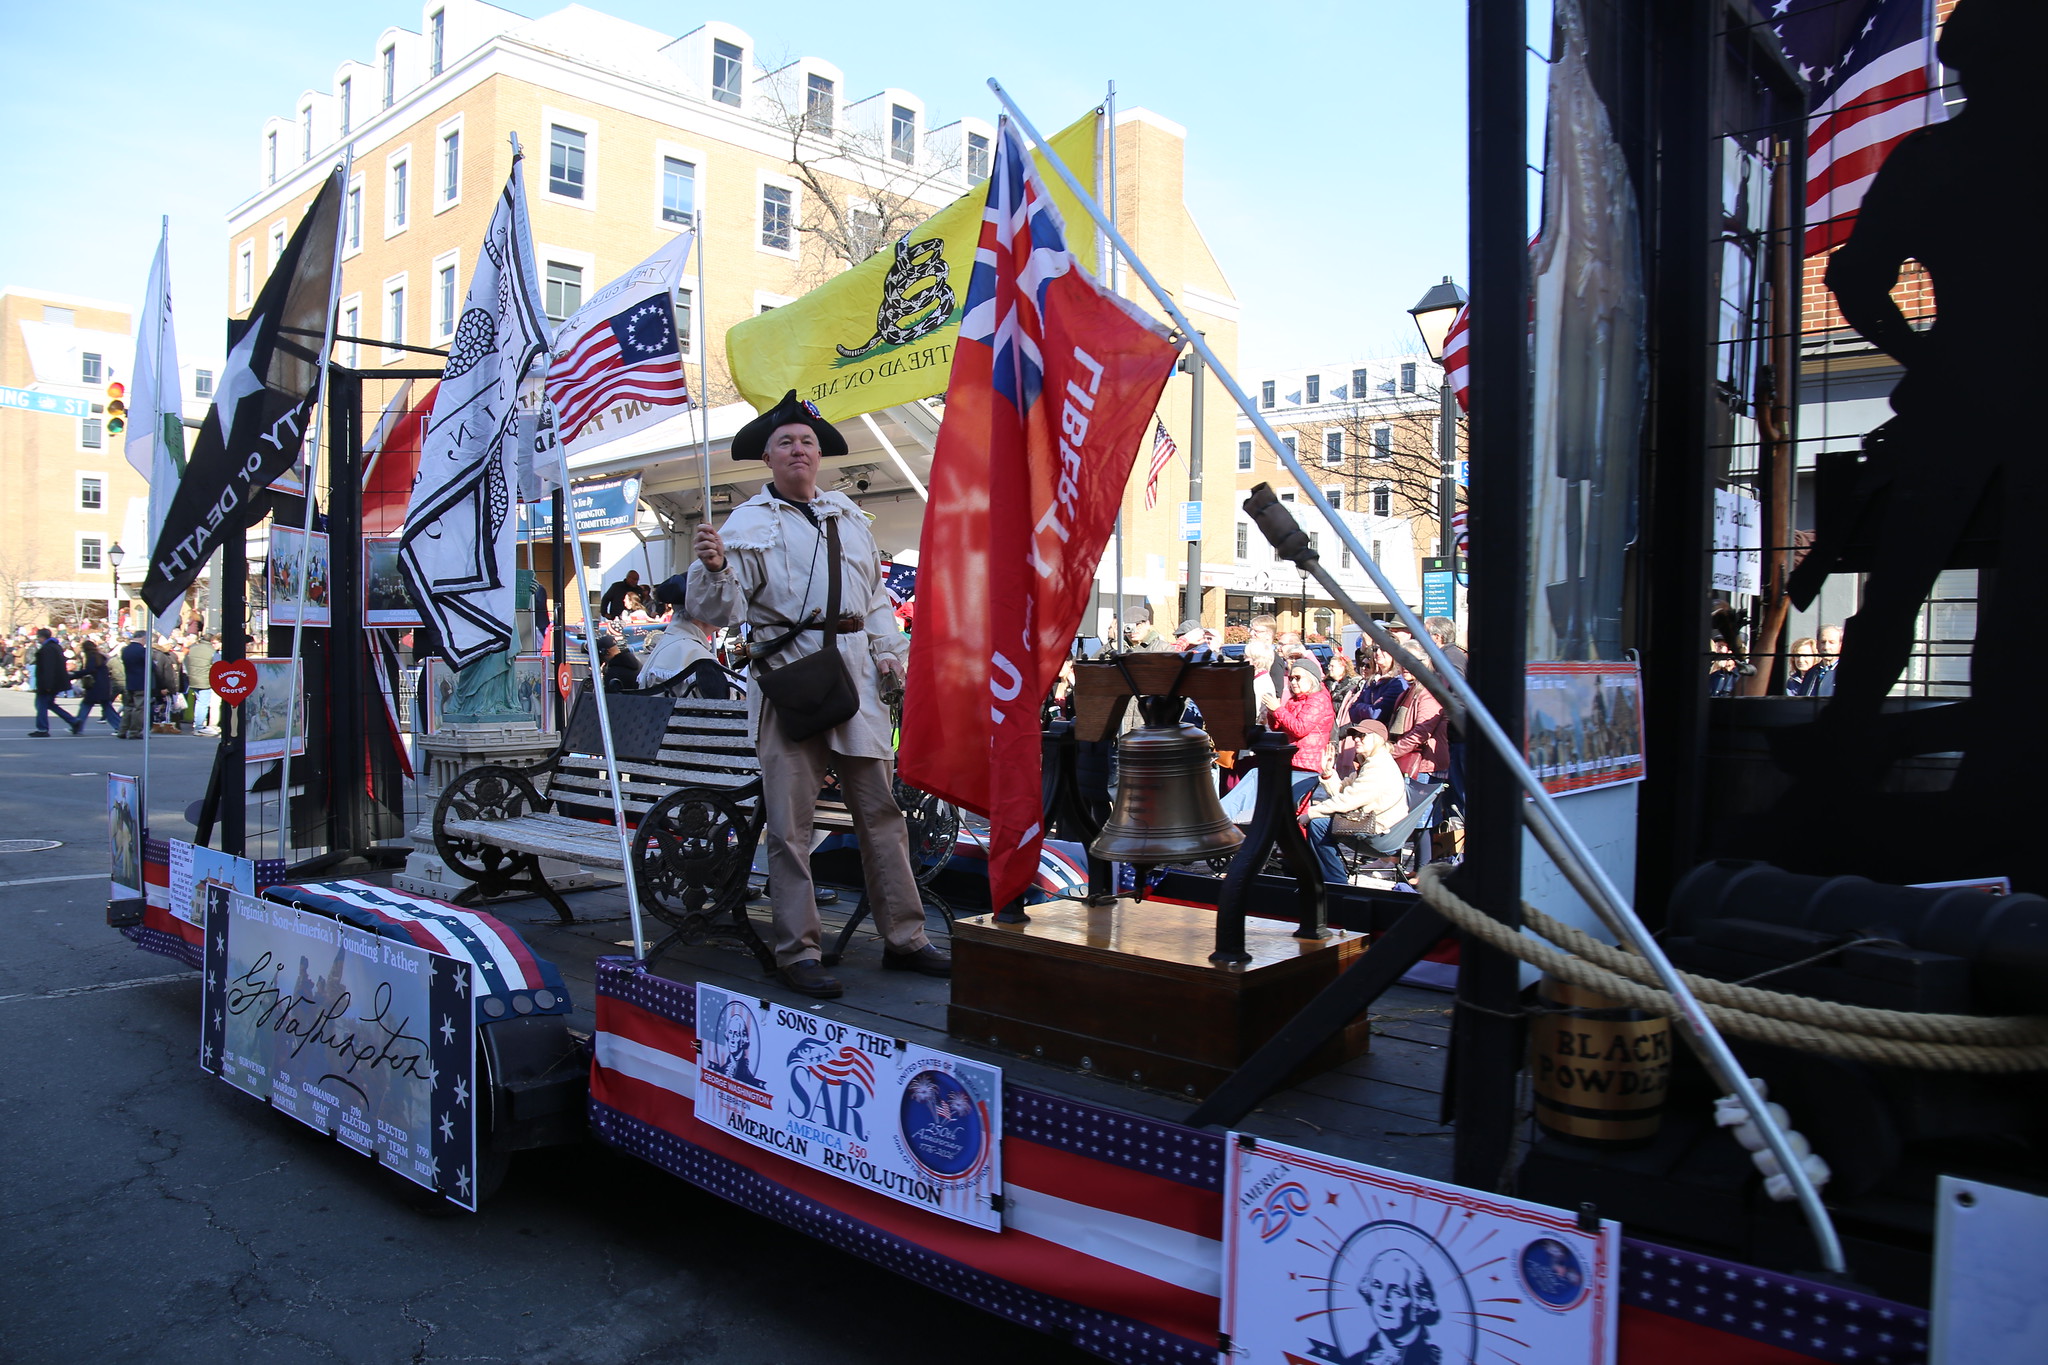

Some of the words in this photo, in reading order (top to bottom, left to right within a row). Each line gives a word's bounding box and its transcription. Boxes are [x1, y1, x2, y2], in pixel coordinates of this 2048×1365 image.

[64, 399, 85, 415] ST
[218, 670, 247, 680] Alexandria
[220, 686, 248, 694] George
[235, 898, 269, 924] Virginia's
[272, 910, 334, 944] Son-America's
[336, 929, 379, 963] Founding
[382, 945, 419, 974] Father
[777, 1009, 818, 1036] SONS
[825, 1023, 848, 1044] OF
[856, 1032, 894, 1059] THE
[1556, 1030, 1668, 1063] BLACK
[238, 1055, 266, 1076] SURVEYOR
[897, 1062, 918, 1086] UNITED
[918, 1058, 942, 1068] STATES
[943, 1061, 953, 1070] OF
[272, 1078, 298, 1099] MARRIED
[302, 1081, 340, 1109] COMMANDER
[704, 1072, 728, 1089] GEORGE
[727, 1081, 770, 1105] WASHINGTON
[273, 1092, 297, 1112] MARTHA
[311, 1100, 330, 1117] ARMY
[350, 1105, 362, 1119] 1789
[787, 1065, 868, 1143] SAR
[315, 1113, 326, 1127] 1775
[342, 1111, 371, 1134] ELECTED
[377, 1119, 408, 1142] ELECTED
[339, 1125, 374, 1150] PRESIDENT
[388, 1139, 409, 1159] TERM
[786, 1119, 843, 1151] AMERICA
[848, 1141, 868, 1159] 250
[386, 1150, 399, 1165] 1793
[416, 1143, 430, 1159] 1799
[728, 1112, 808, 1158] AMERICAN
[823, 1147, 943, 1207] REVOLUTION
[414, 1160, 432, 1177] DIED
[1238, 1164, 1291, 1210] AMERICA
[1248, 1181, 1312, 1244] 250
